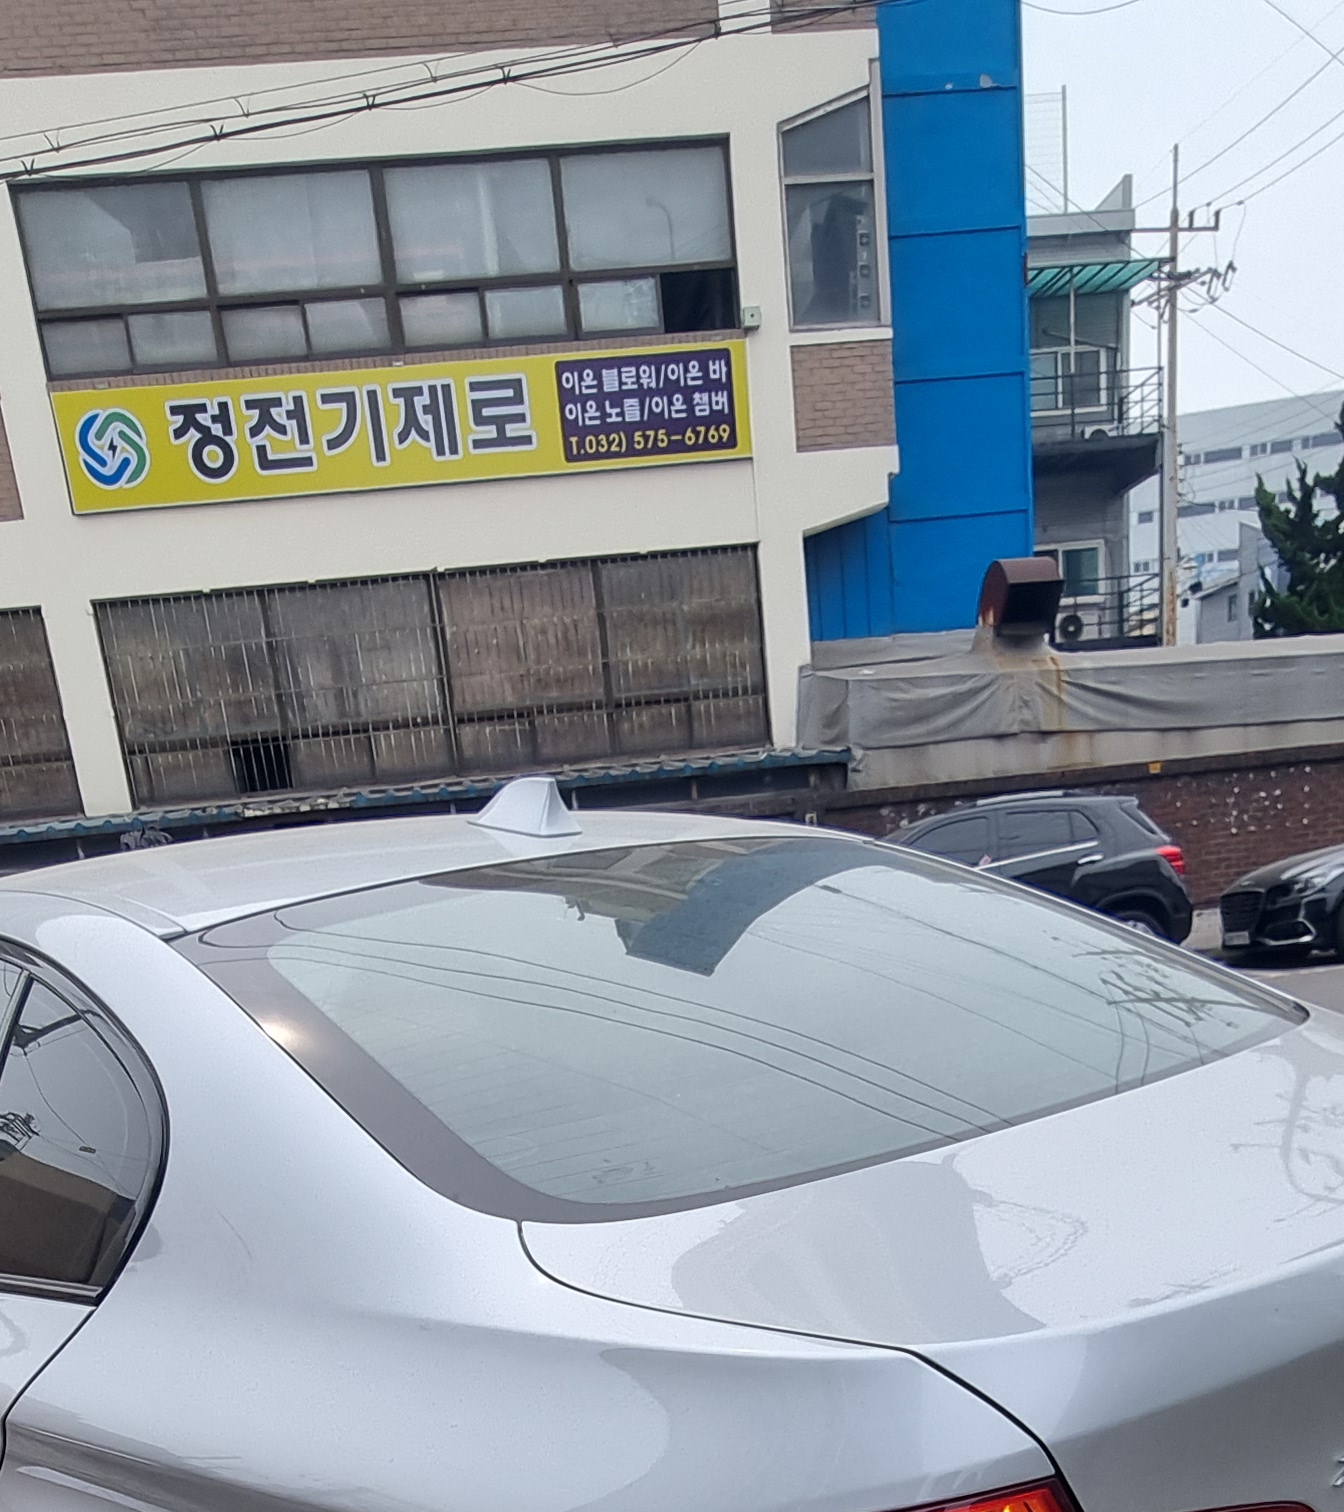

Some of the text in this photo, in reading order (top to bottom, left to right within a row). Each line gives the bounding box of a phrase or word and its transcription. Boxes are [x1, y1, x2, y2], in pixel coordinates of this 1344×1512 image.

[561, 368, 598, 395] 이온
[708, 358, 728, 383] 바
[564, 400, 601, 427] 이온
[692, 389, 729, 417] 챔버
[166, 375, 536, 482] 정전기제로
[568, 423, 731, 456] T.032) 575-6769
